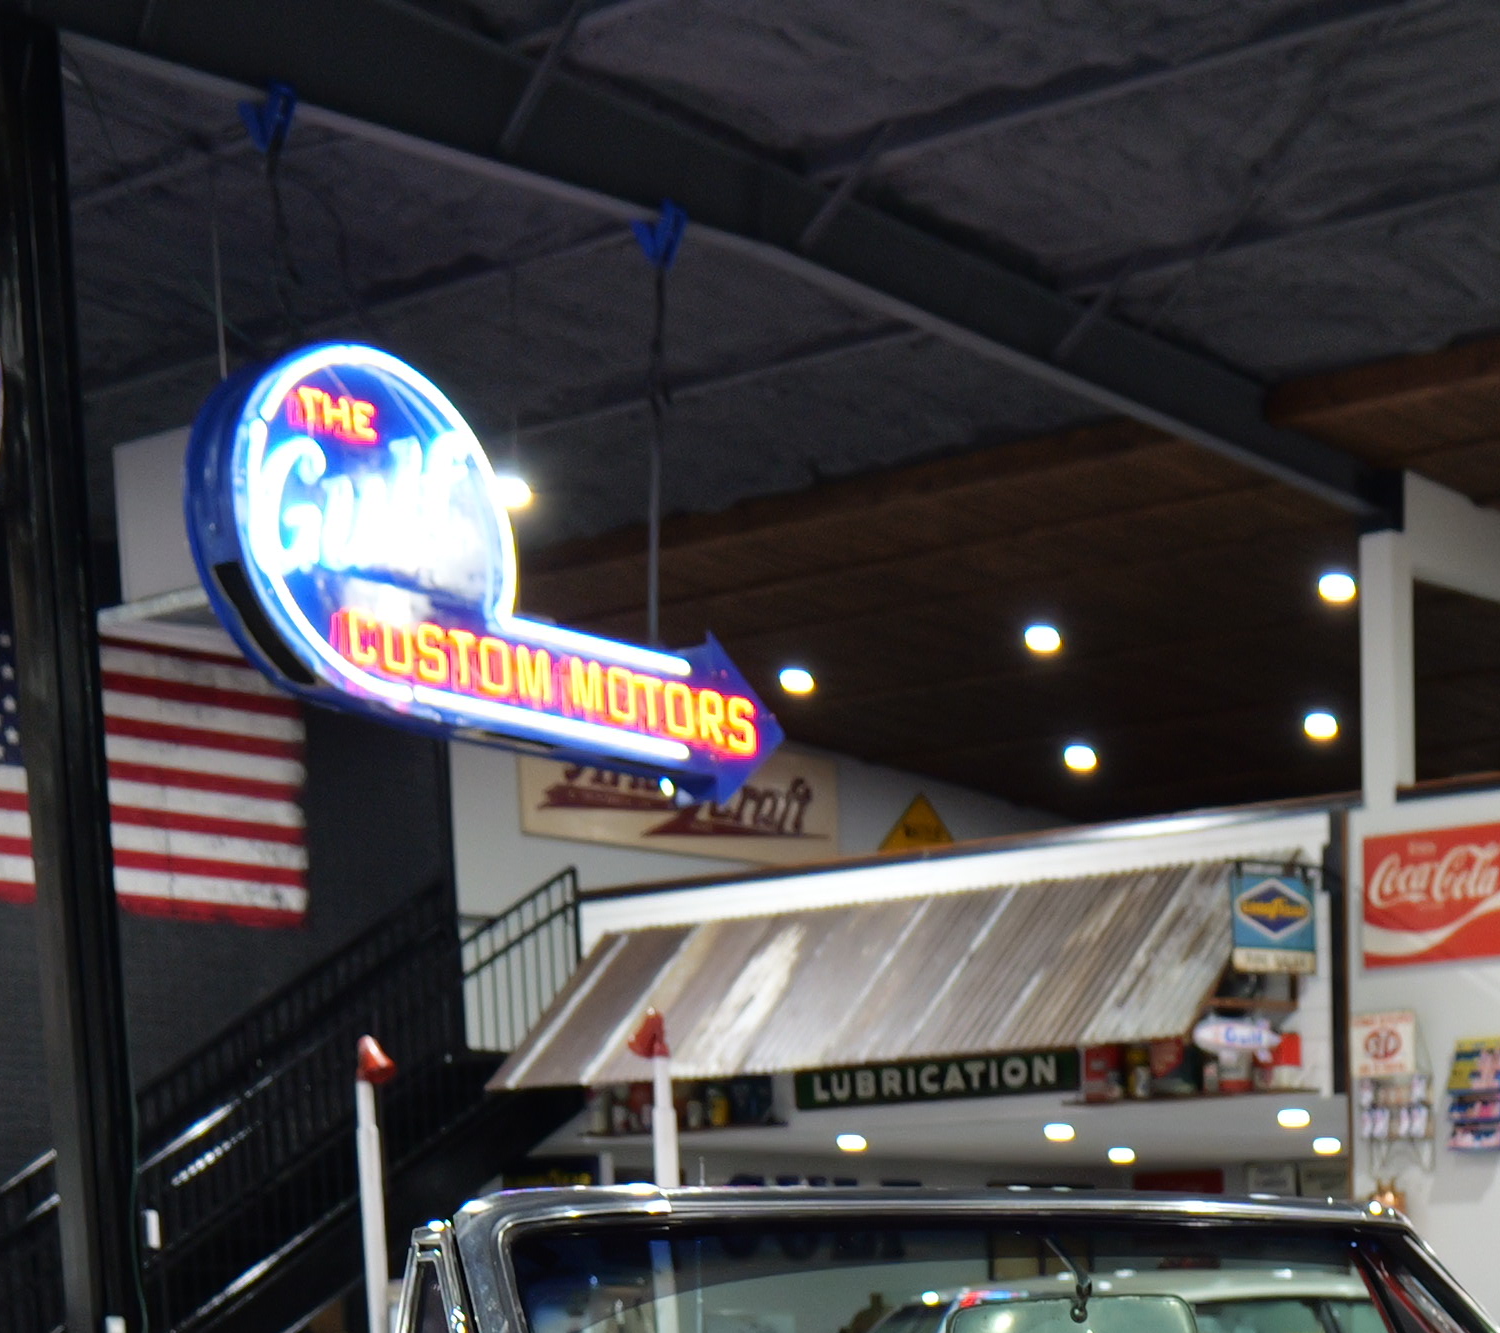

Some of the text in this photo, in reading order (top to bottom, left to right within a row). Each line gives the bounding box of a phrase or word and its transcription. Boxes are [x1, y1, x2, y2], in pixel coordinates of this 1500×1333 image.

[287, 385, 378, 444] THE
[330, 609, 759, 760] CUSTOM MOTORS
[813, 1054, 1058, 1102] LUBRICATION
